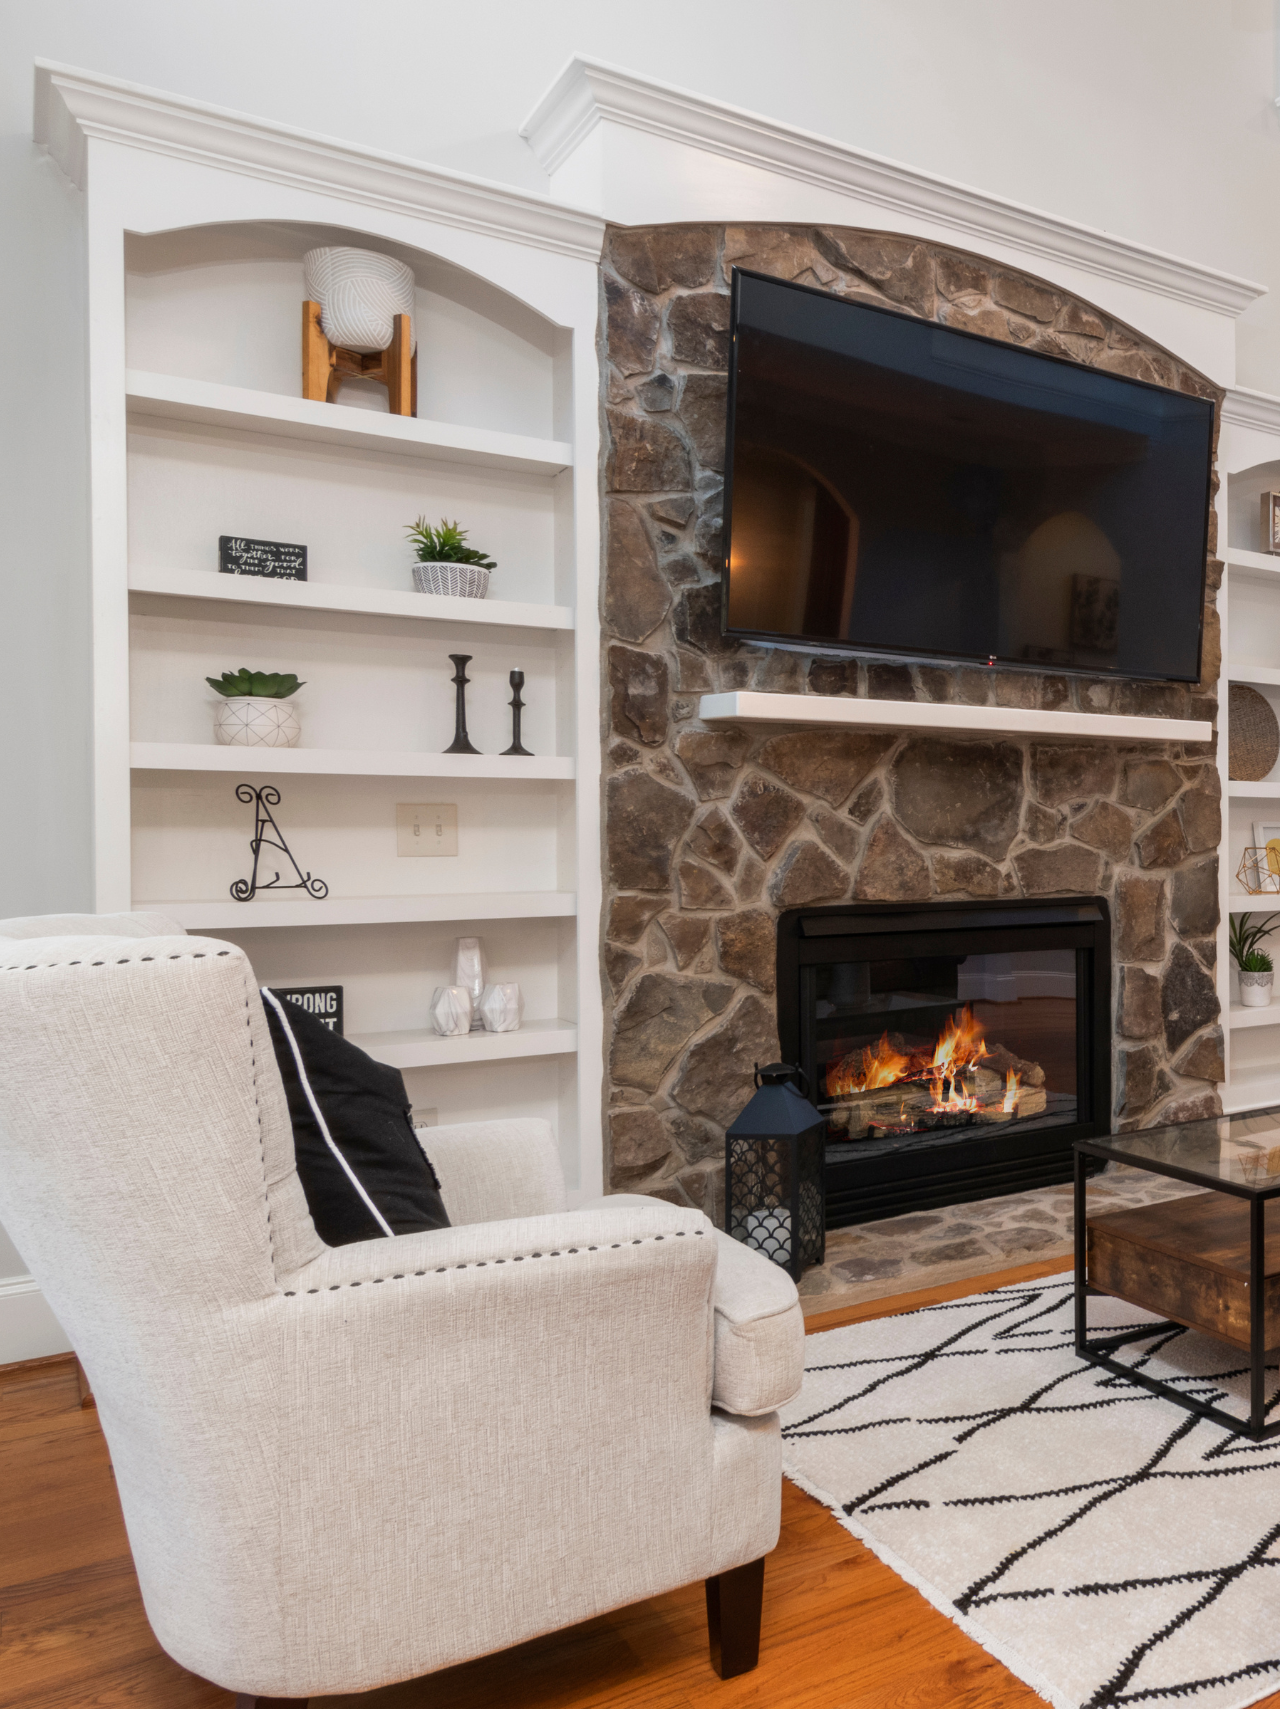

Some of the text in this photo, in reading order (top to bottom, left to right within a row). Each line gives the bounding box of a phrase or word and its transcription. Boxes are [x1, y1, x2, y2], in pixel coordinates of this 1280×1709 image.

[227, 538, 247, 552] All
[228, 550, 275, 564] together
[261, 557, 303, 573] good
